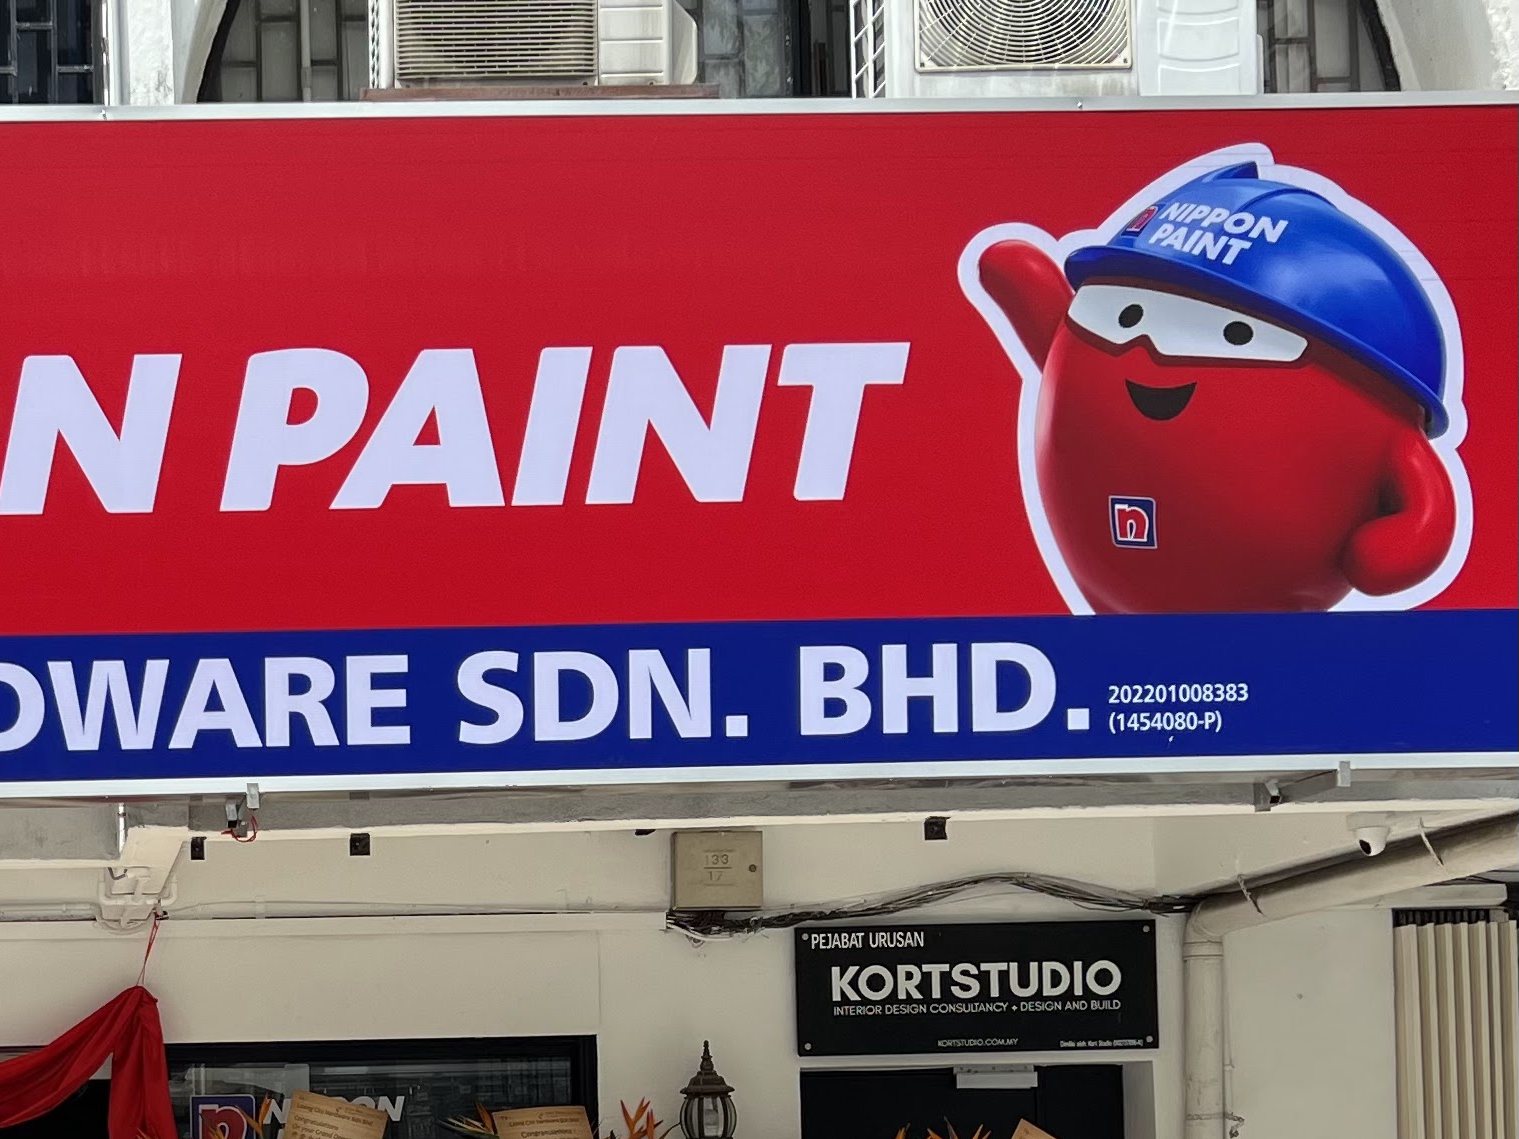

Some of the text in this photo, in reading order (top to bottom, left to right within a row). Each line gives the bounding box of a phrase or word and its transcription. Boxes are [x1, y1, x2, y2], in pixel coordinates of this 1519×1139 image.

[1159, 202, 1288, 243] NIPPON
[1149, 223, 1252, 265] PAINT
[220, 341, 910, 512] PAINT
[457, 648, 747, 744] SDN.
[799, 642, 1089, 737] BHD.
[1108, 683, 1249, 703] 202201008383
[1108, 710, 1222, 734] (1454080-P)
[811, 931, 924, 949] PEJABAT URUSAN
[831, 959, 1122, 1001] KORTSTUDIO
[833, 999, 1122, 1016] INTERIOR DESIGN CONSULTANCY DESIGN AND BUILD
